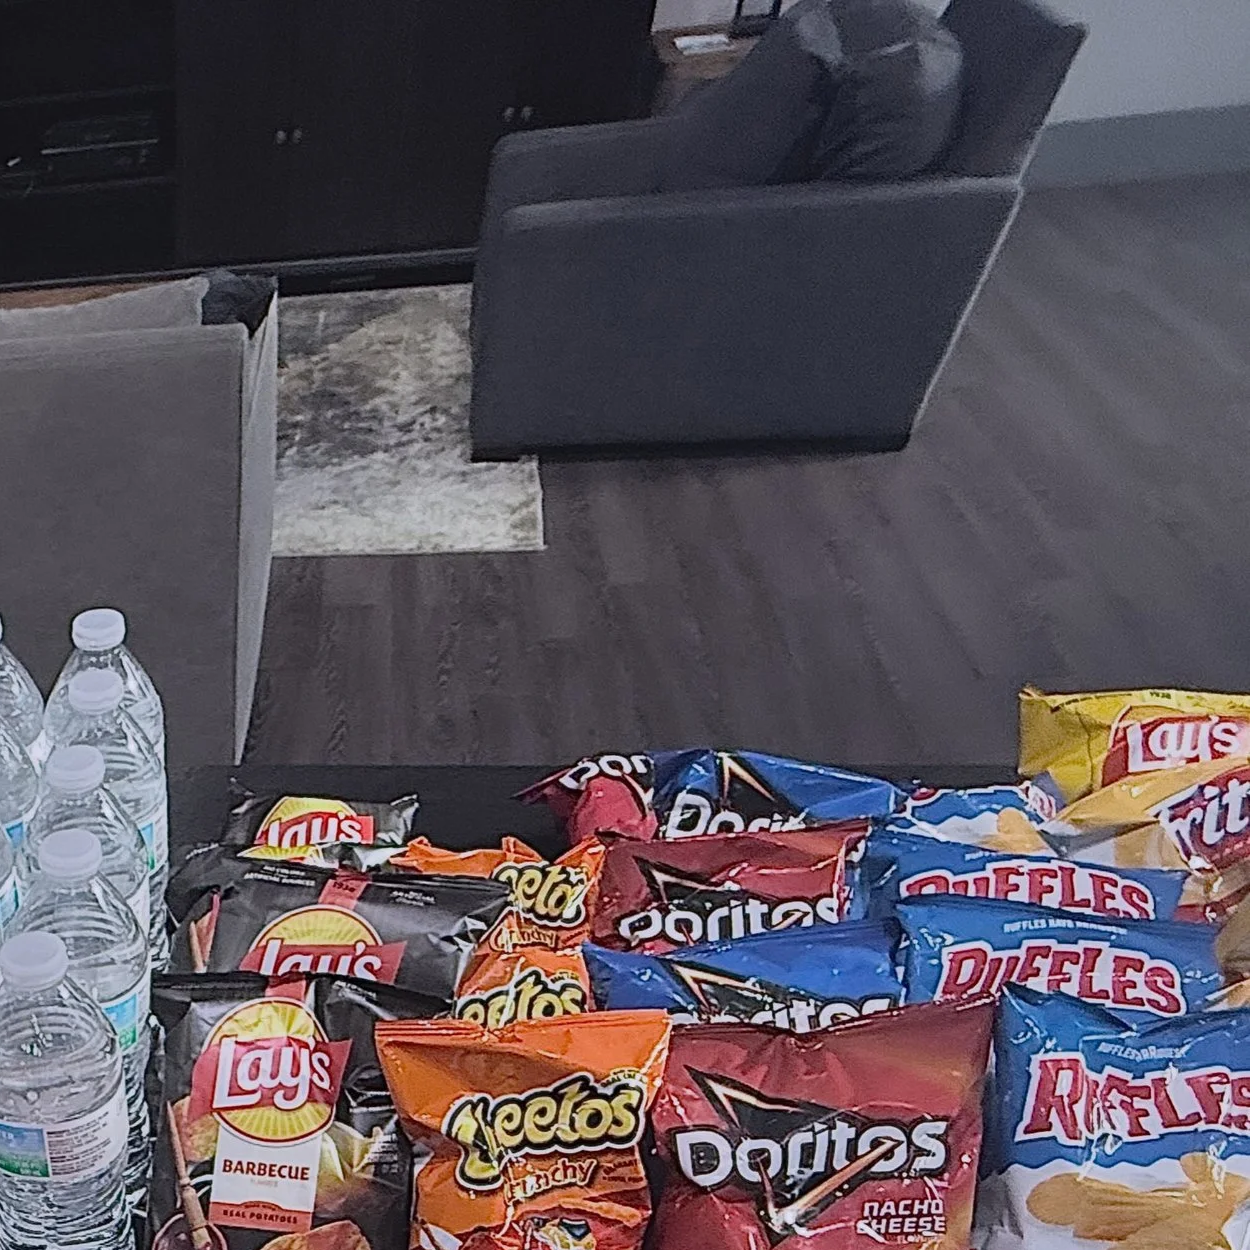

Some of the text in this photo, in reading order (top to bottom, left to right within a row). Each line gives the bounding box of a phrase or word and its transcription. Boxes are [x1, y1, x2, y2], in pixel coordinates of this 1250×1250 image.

[1126, 715, 1241, 773] Lay's
[663, 792, 808, 840] Dorit
[1145, 778, 1250, 866] Frit
[490, 925, 557, 951] Crnchy
[461, 976, 582, 1029] eetos
[671, 997, 894, 1034] ritos
[212, 1035, 331, 1110] Lay's
[222, 1158, 310, 1181] BARBECUE
[675, 1118, 949, 1187] Doritos
[249, 1212, 298, 1225] POTATOES
[857, 1216, 946, 1234] CHEESE
[863, 1199, 944, 1217] NACHO
